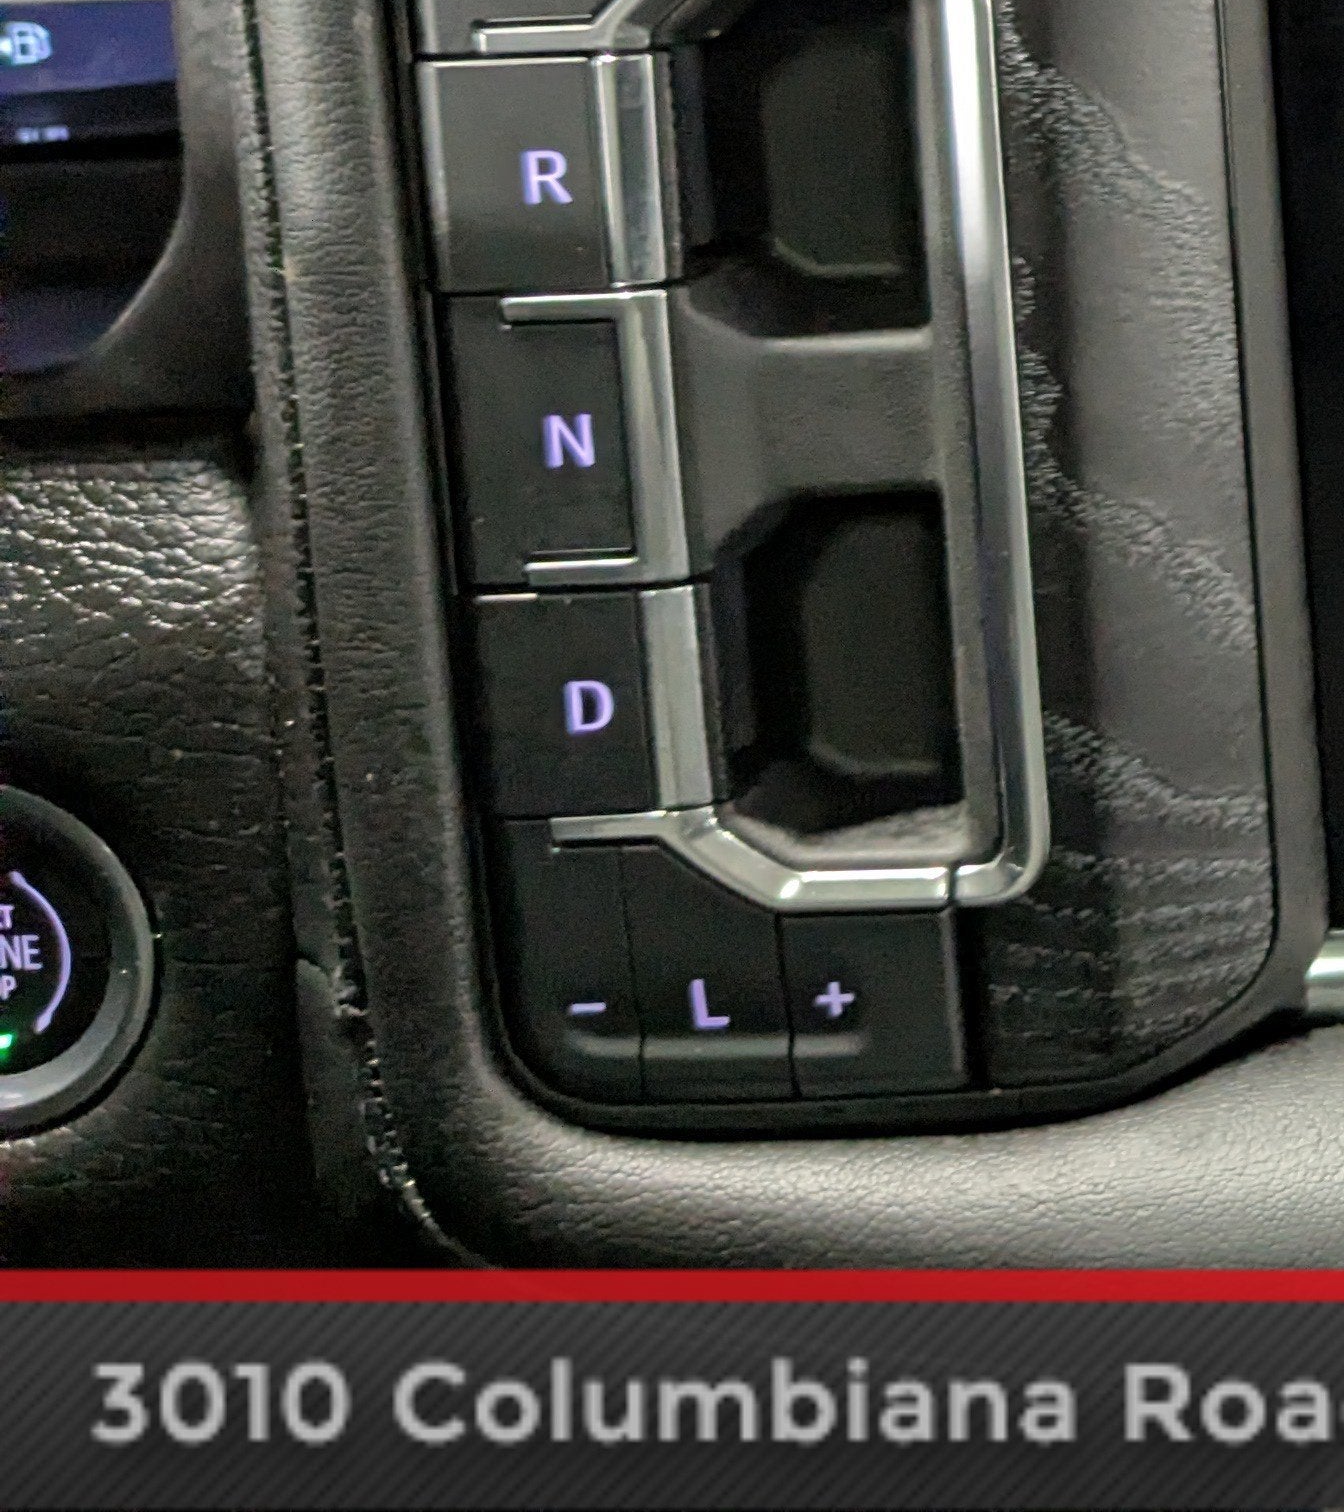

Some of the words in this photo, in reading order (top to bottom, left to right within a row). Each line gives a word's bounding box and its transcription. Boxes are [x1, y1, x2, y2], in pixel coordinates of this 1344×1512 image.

[521, 149, 573, 206] R
[543, 412, 596, 469] N
[564, 679, 616, 735] D
[690, 977, 731, 1030] L
